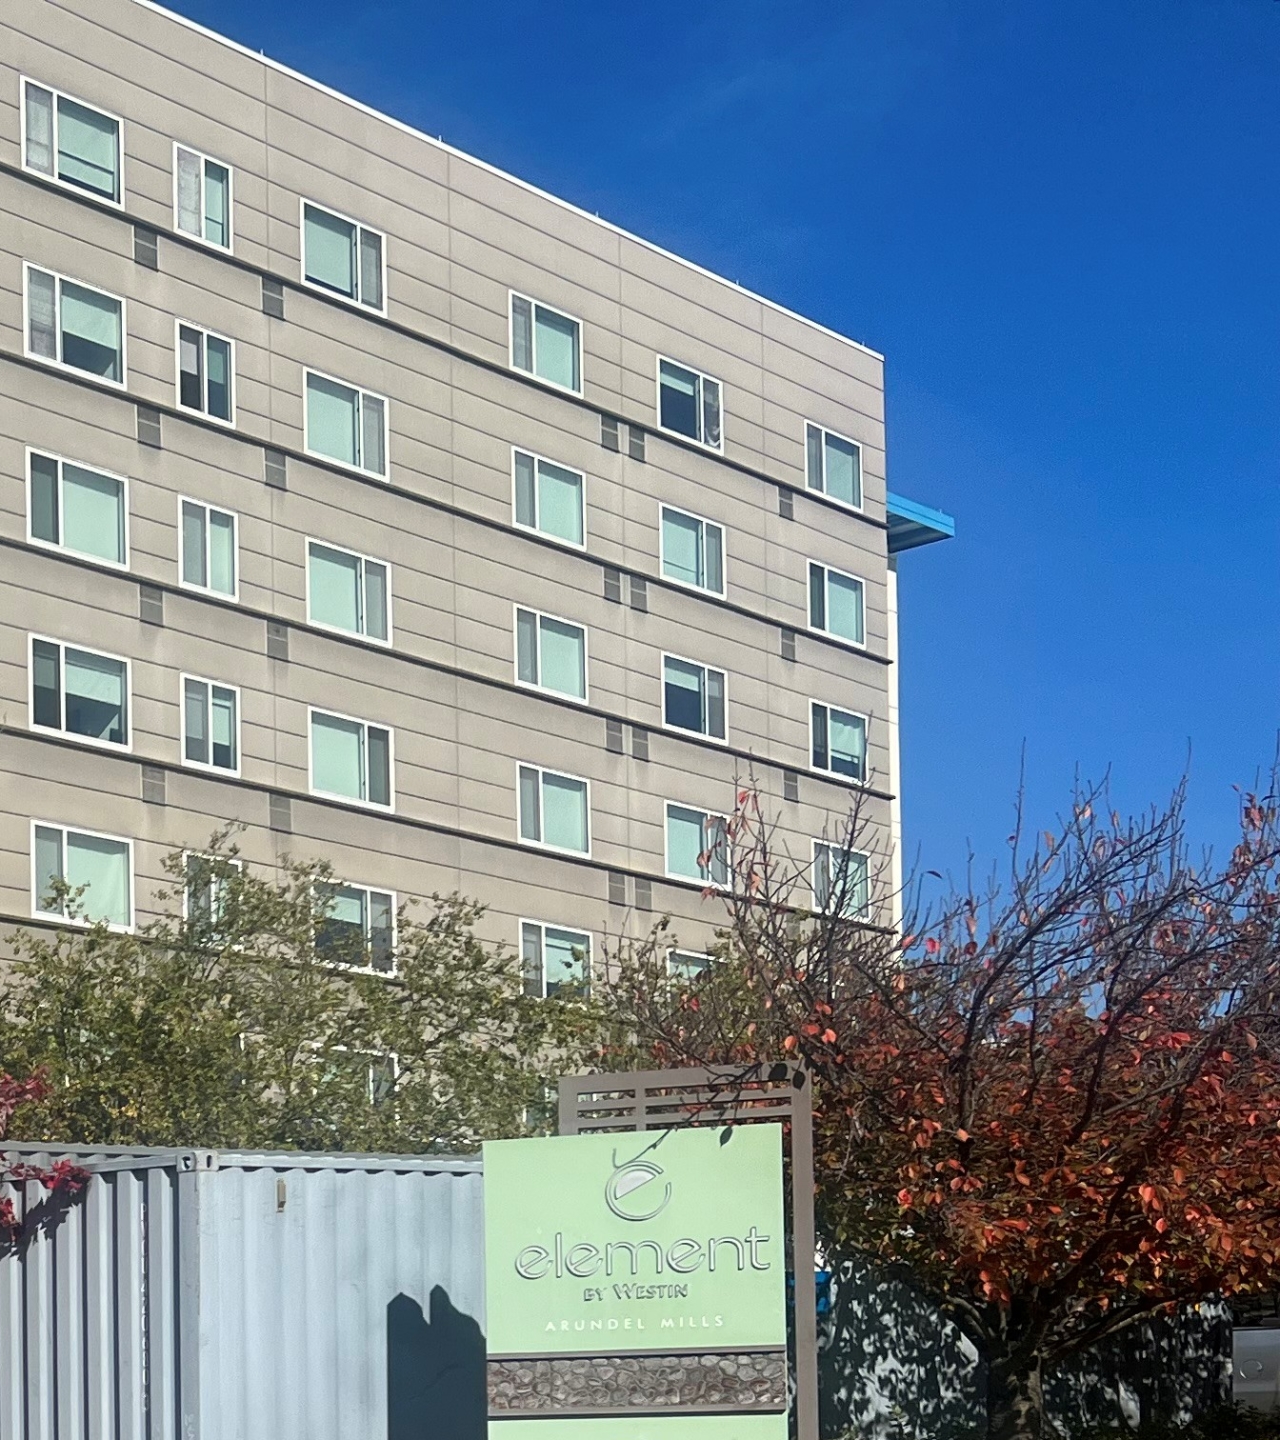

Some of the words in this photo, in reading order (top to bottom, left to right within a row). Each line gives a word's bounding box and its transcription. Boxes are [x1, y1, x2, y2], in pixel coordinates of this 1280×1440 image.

[514, 1226, 771, 1280] element
[583, 1287, 607, 1301] BY
[612, 1283, 688, 1300] WESTIN
[545, 1318, 645, 1332] ARUNDEL
[660, 1315, 724, 1329] MILLS
